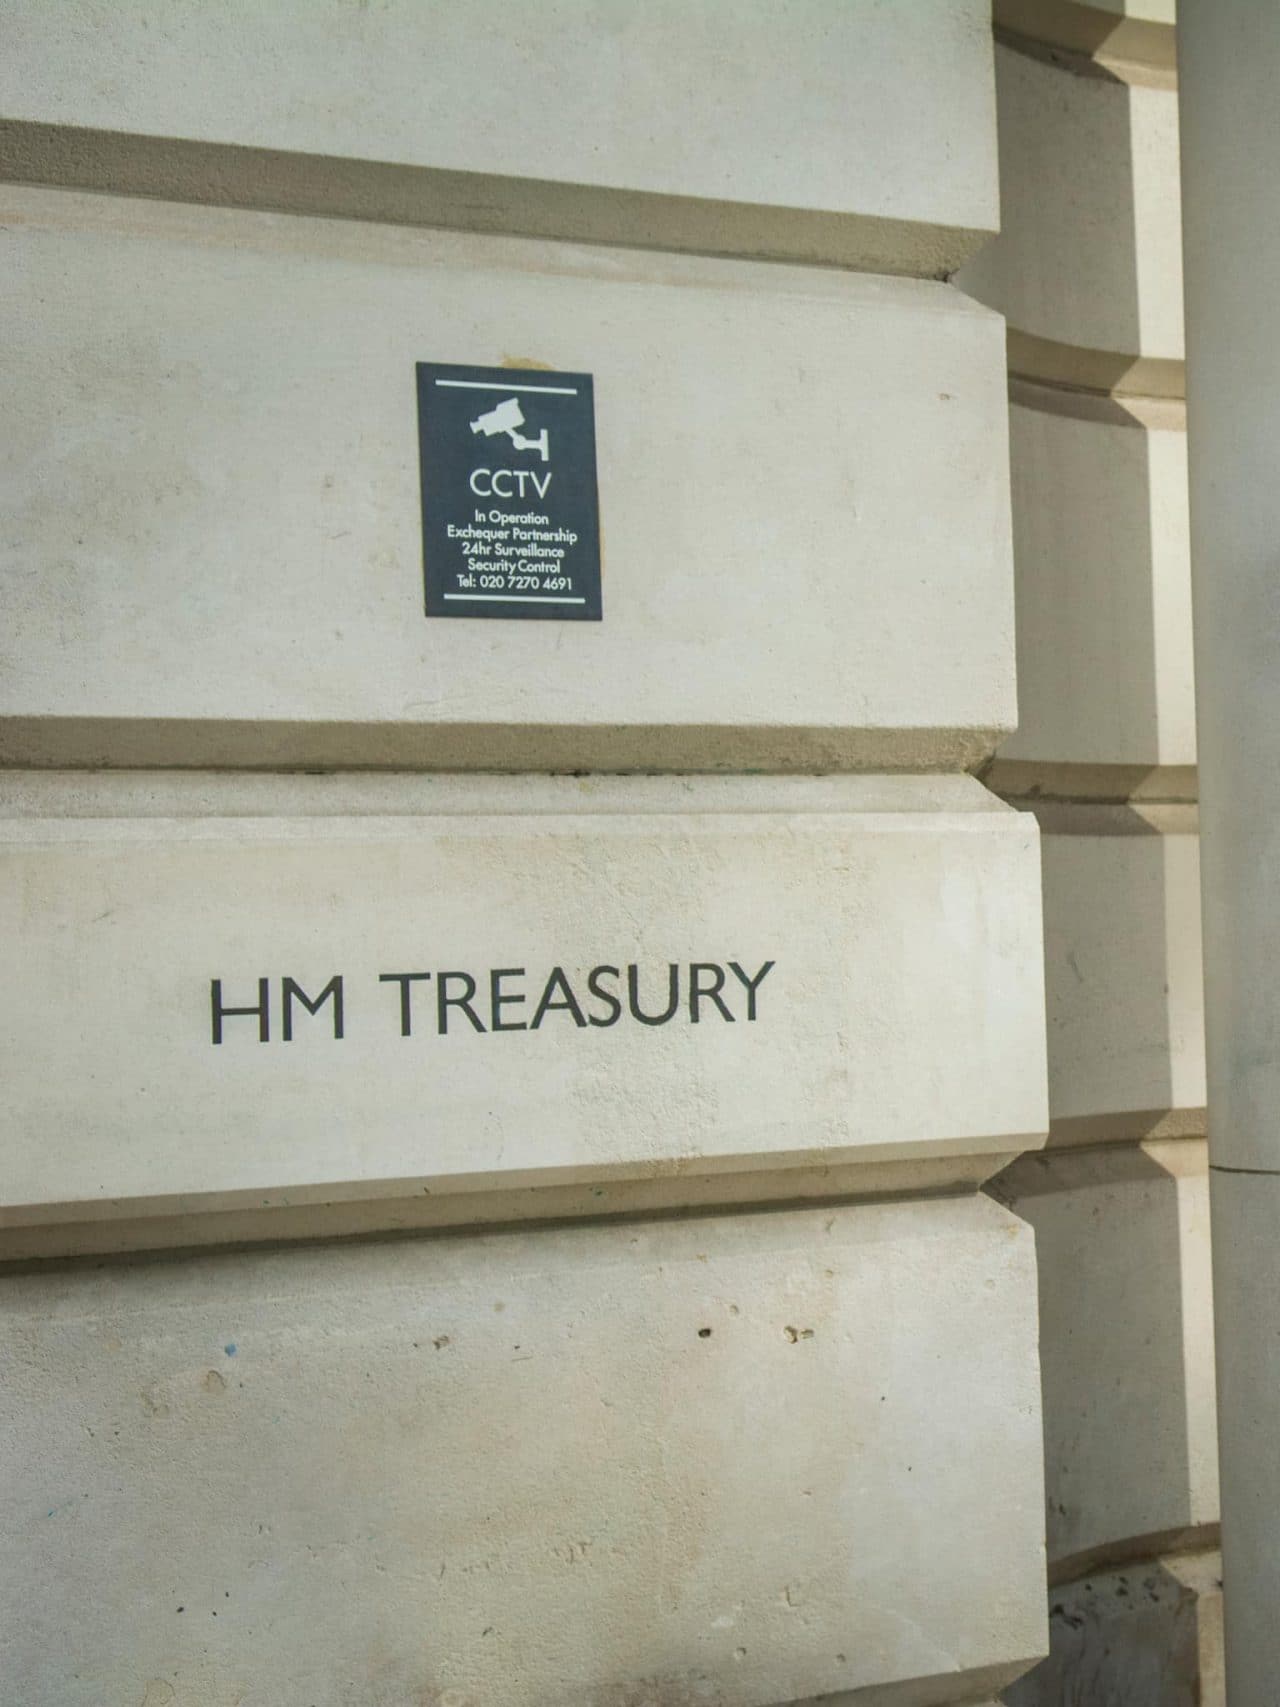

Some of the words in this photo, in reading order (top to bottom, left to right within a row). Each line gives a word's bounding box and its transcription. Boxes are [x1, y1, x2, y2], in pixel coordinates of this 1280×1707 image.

[469, 468, 552, 499] CCTV
[474, 508, 486, 523] In
[489, 510, 549, 526] Operation
[447, 524, 510, 542] Exchequer
[513, 527, 578, 545] Partnership
[462, 542, 492, 556] 24hr
[494, 543, 565, 558] Surveillance
[468, 558, 517, 575] Security
[518, 560, 561, 573] Control
[457, 575, 477, 588] Tel:
[479, 576, 504, 589] 020
[507, 577, 540, 590] 7270
[543, 577, 573, 591] 4691
[210, 974, 345, 1046] HM
[379, 960, 776, 1037] TREASURY
